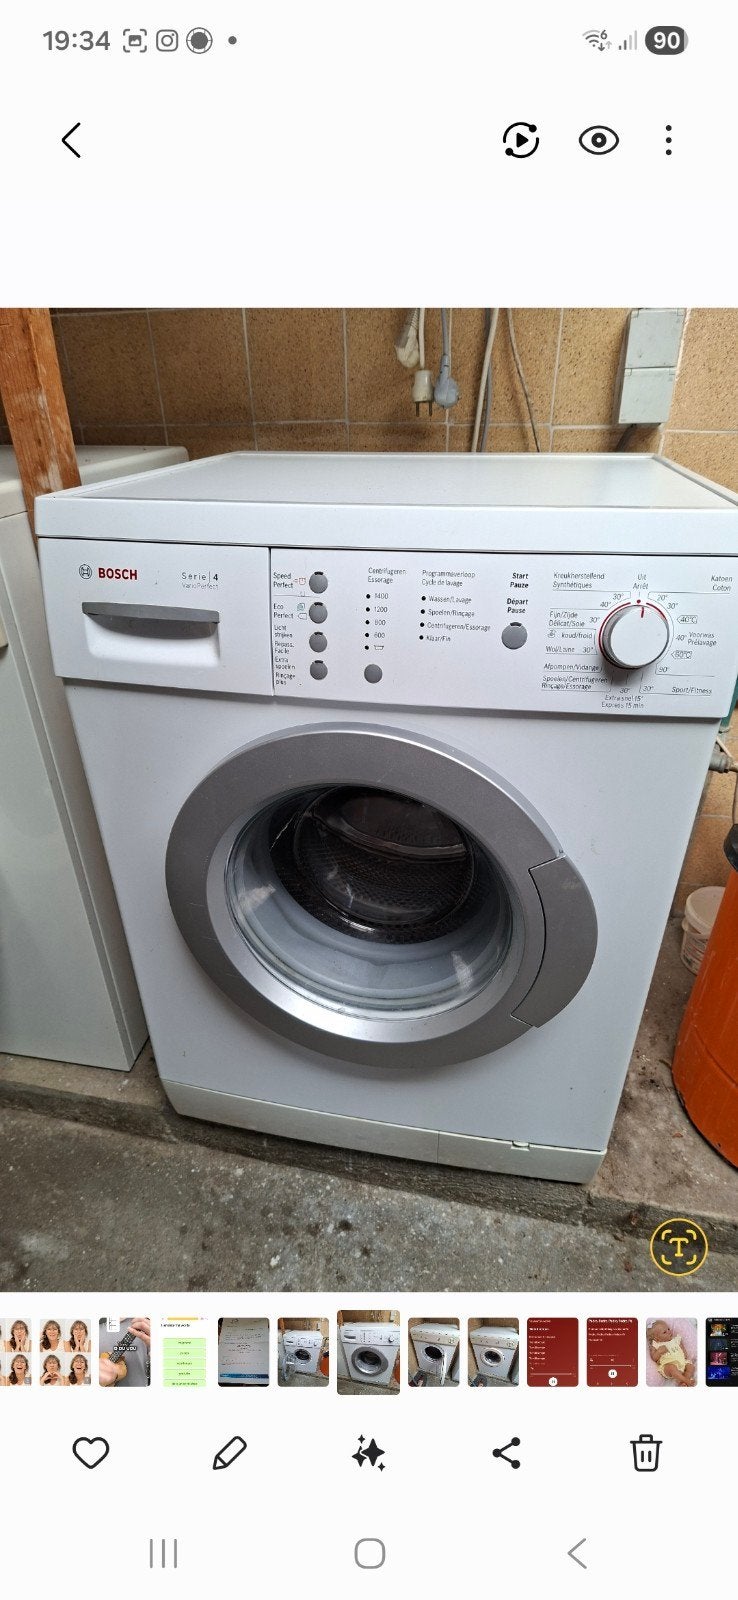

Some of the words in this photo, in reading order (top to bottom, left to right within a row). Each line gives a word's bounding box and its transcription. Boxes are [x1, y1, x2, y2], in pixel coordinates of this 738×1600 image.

[43, 31, 110, 51] 19:34
[653, 30, 680, 50] 90
[98, 567, 138, 581] BOSCH
[368, 567, 406, 576] Centrifugeren
[512, 572, 529, 580] Start
[181, 572, 206, 581] Serie
[213, 573, 218, 581] 4
[273, 572, 292, 581] Speed
[368, 576, 393, 584] Essorage
[637, 573, 647, 581] Uit
[711, 575, 733, 583] Katoen
[421, 578, 437, 587] Cycle
[445, 579, 463, 588] lavage
[509, 581, 529, 589] Pauze
[552, 581, 593, 590] Synthétiques
[632, 582, 649, 590] Arrêt
[712, 584, 732, 593] Coton
[374, 592, 389, 600] 1400
[428, 595, 472, 604] Wassen/Lavage
[506, 597, 529, 607] Départ
[549, 611, 578, 620] Fijn/Zijde
[548, 618, 585, 627] Délicat/Soie
[561, 632, 593, 640] koud/froid
[688, 631, 715, 639] Voorwas
[687, 639, 717, 647] Prélavage
[671, 686, 712, 695] Sport/Fitness
